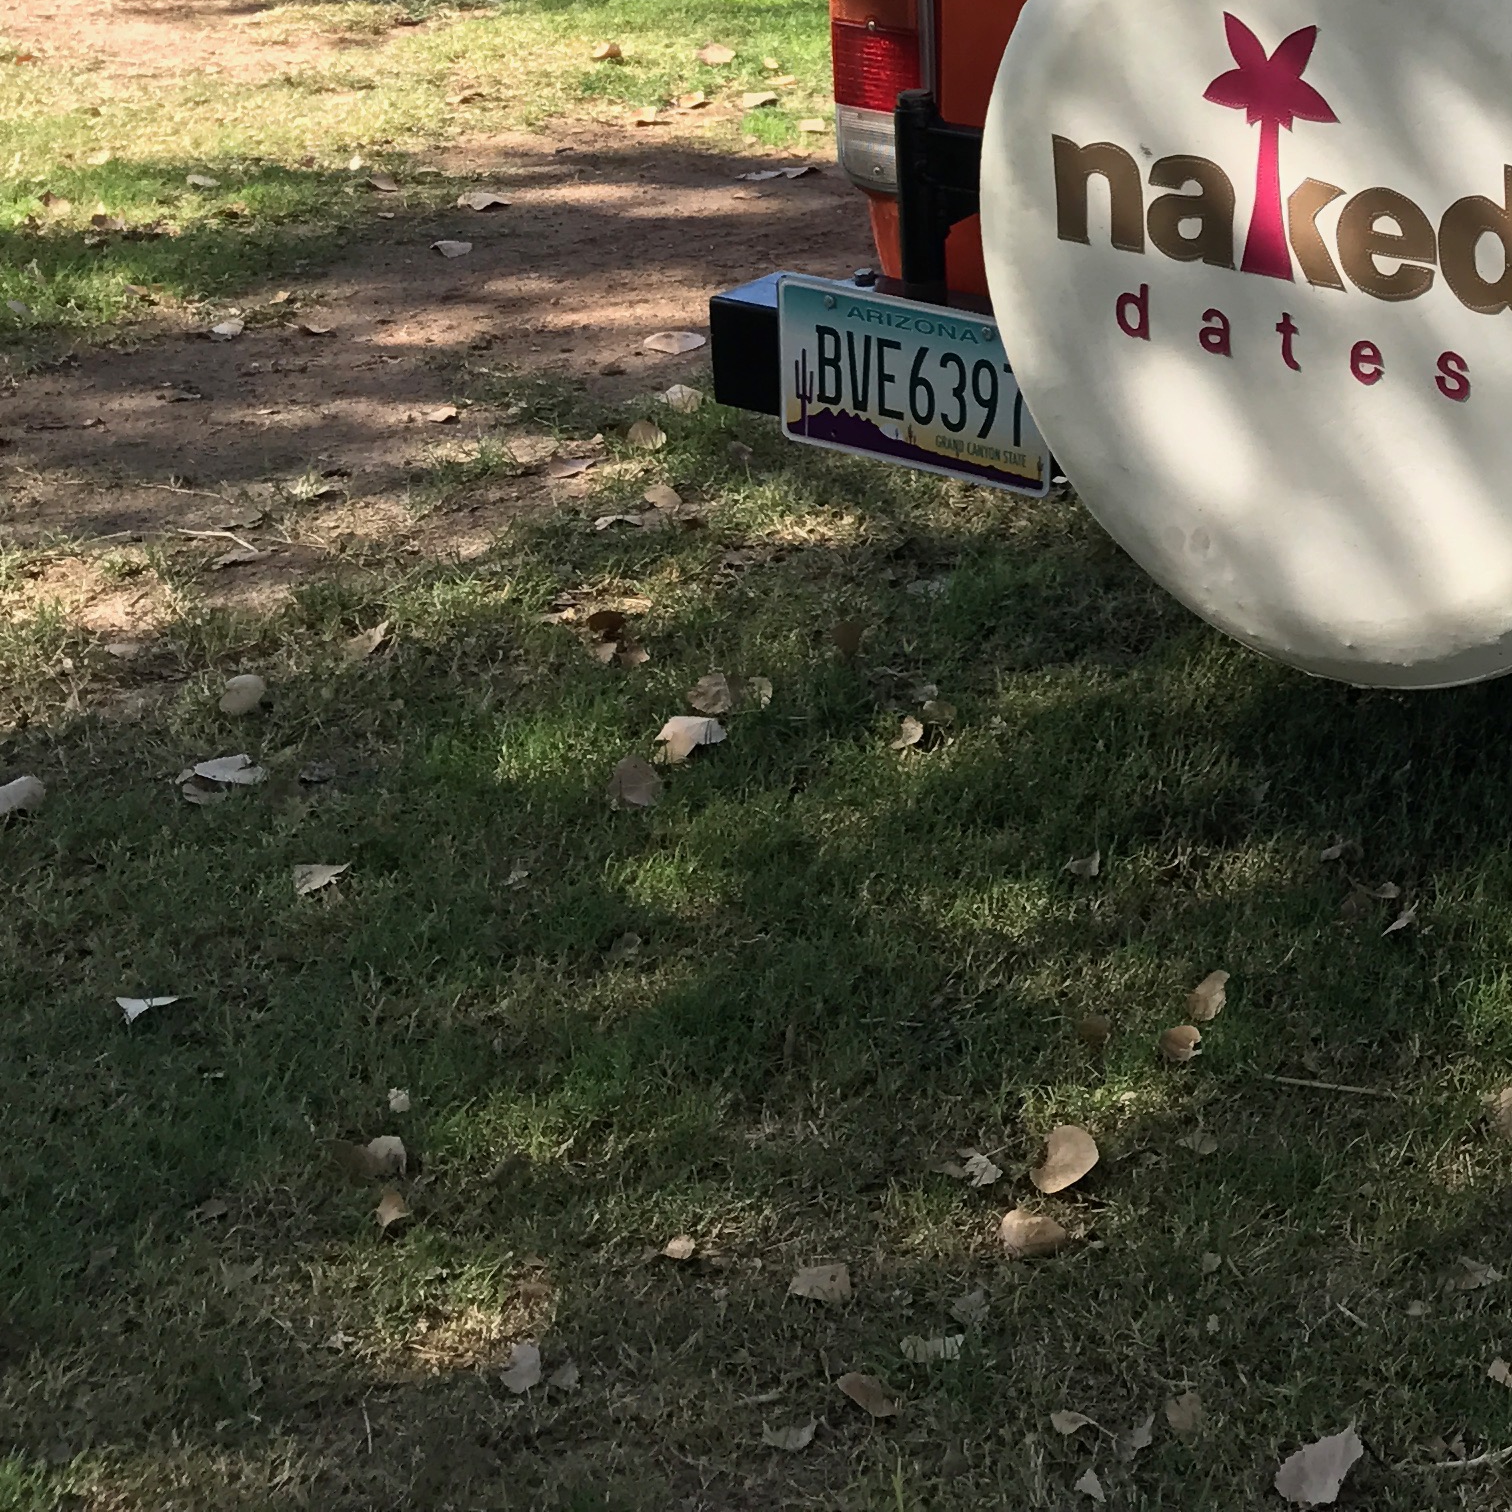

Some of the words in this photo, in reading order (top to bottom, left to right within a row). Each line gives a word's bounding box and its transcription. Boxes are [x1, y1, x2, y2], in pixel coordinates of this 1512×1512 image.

[847, 306, 979, 344] ARIZONA
[1116, 283, 1470, 403] dates
[815, 325, 1022, 447] BVE6397
[935, 435, 965, 455] GRAND
[967, 440, 1001, 462] CANYON
[1003, 450, 1027, 468] STATE
